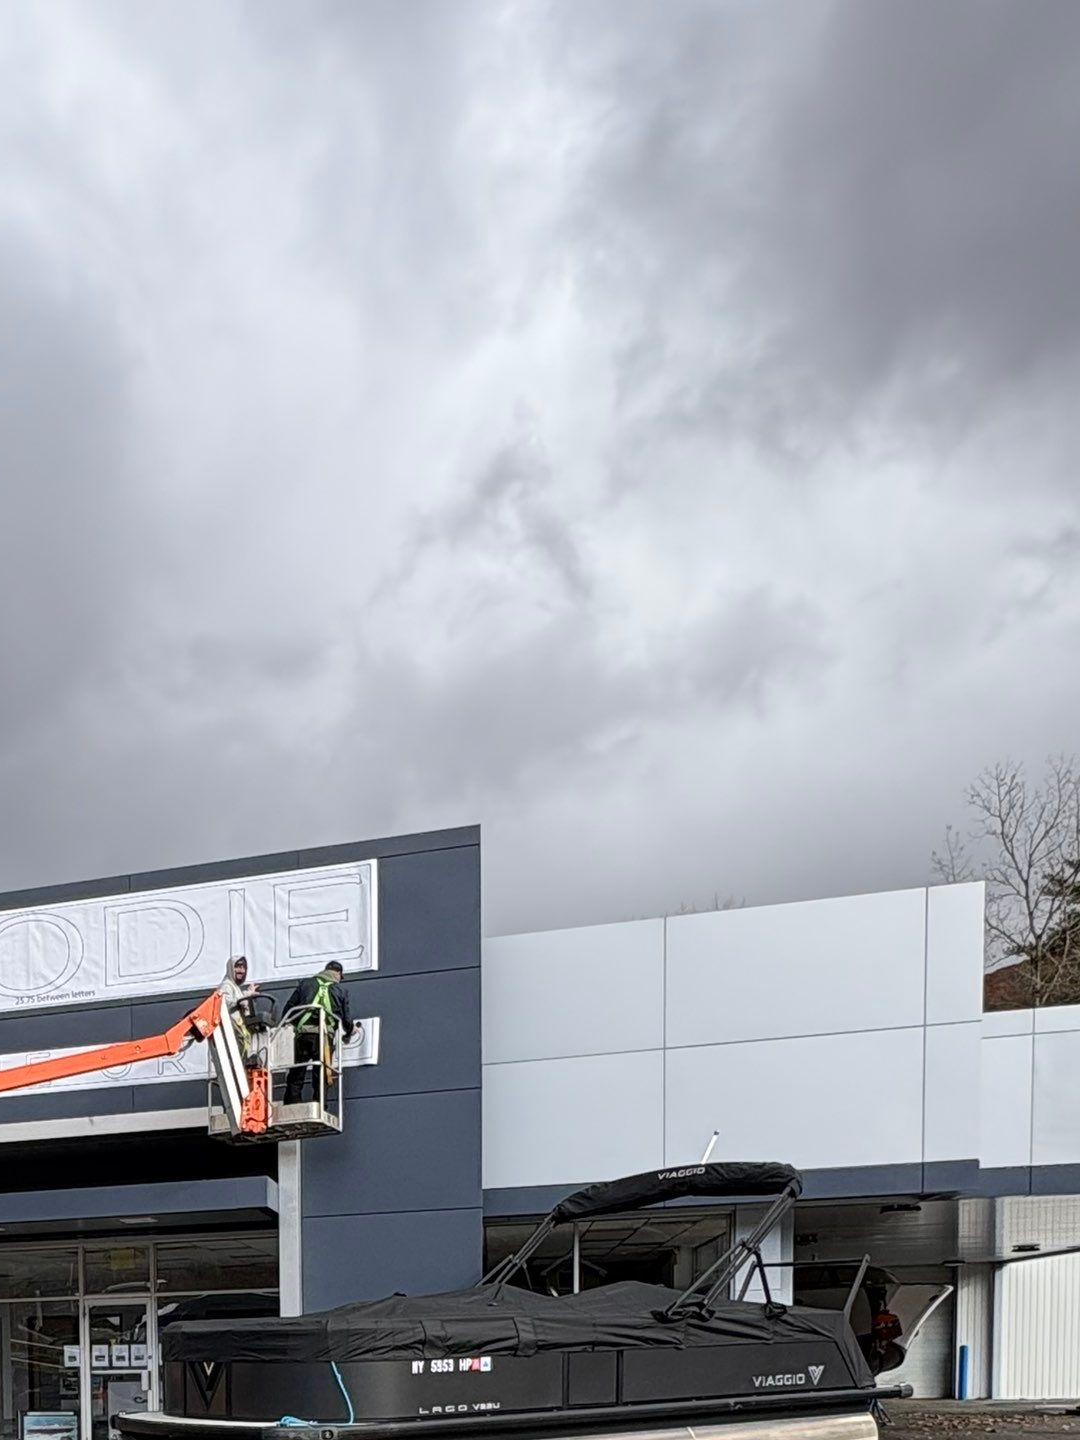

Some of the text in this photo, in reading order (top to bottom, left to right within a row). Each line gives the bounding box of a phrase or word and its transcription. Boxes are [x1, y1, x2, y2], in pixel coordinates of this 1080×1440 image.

[36, 992, 70, 1003] between
[71, 990, 96, 999] letters
[657, 1166, 706, 1180] VIAGGIO
[411, 1360, 425, 1374] NY
[752, 1373, 806, 1387] VIAGGIO
[419, 1404, 468, 1414] LAGO
